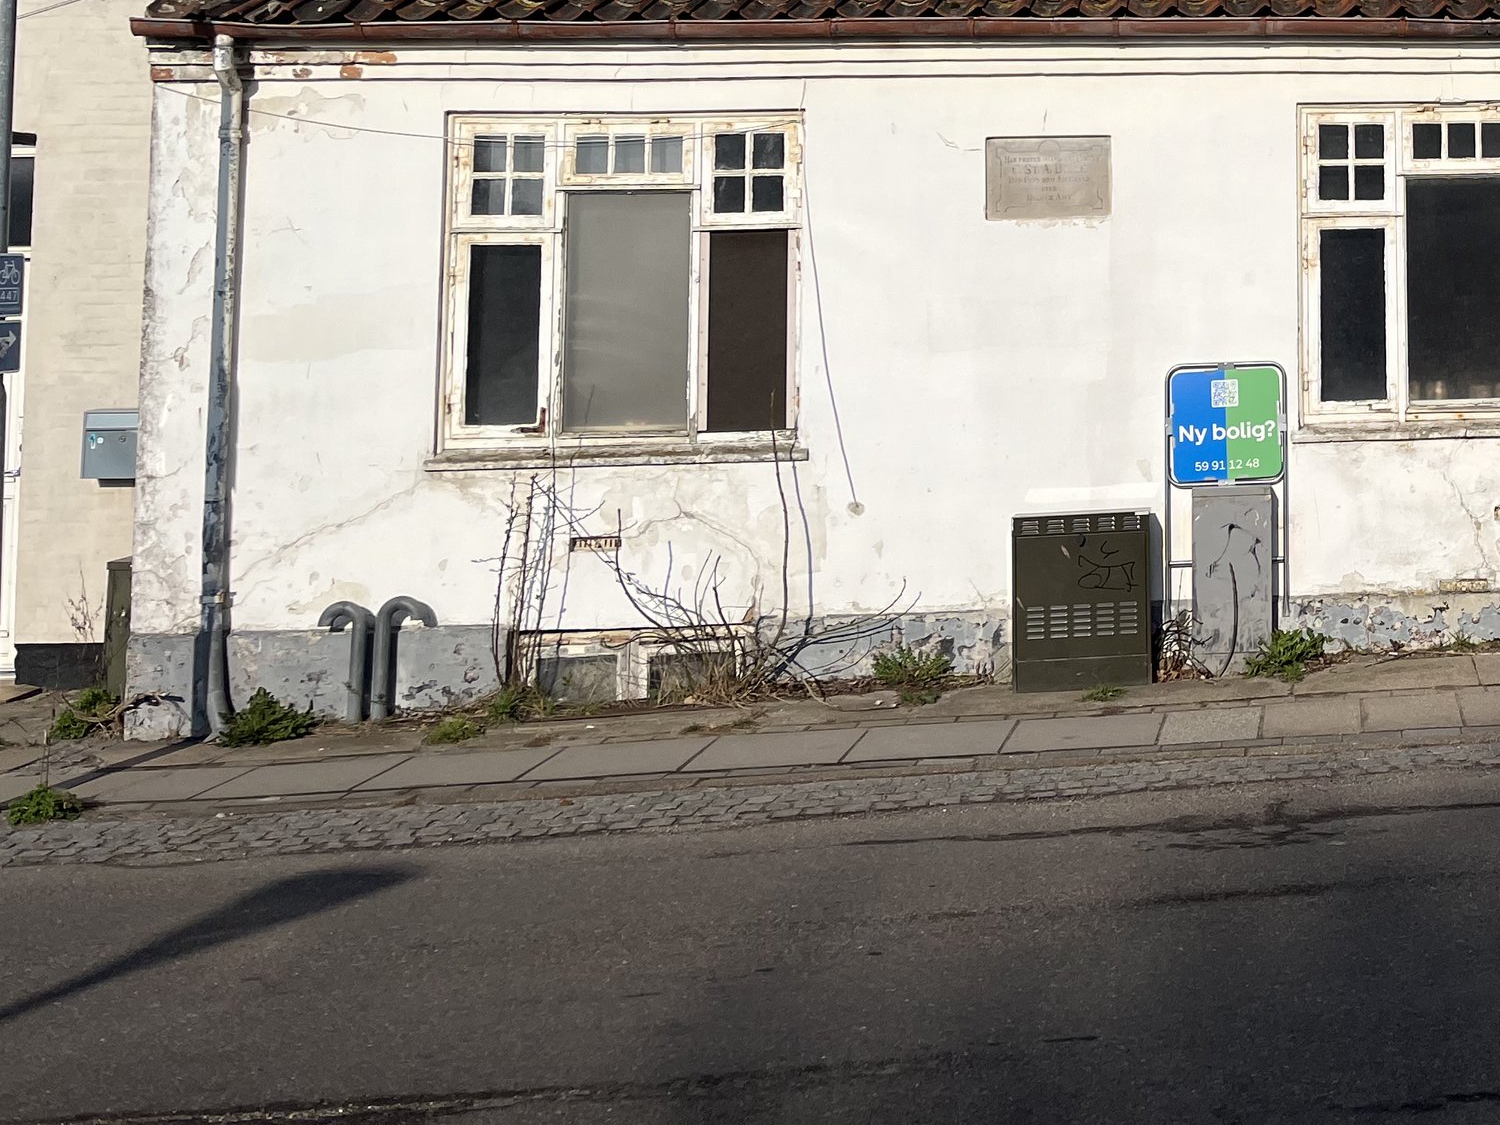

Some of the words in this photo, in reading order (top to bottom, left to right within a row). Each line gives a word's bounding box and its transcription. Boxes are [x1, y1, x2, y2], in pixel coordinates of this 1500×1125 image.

[1179, 425, 1207, 445] Ny
[1212, 420, 1276, 442] bolig?
[1195, 461, 1209, 472] 59
[1211, 460, 1225, 471] 91
[1229, 459, 1243, 470] 12
[1245, 458, 1260, 468] 48
